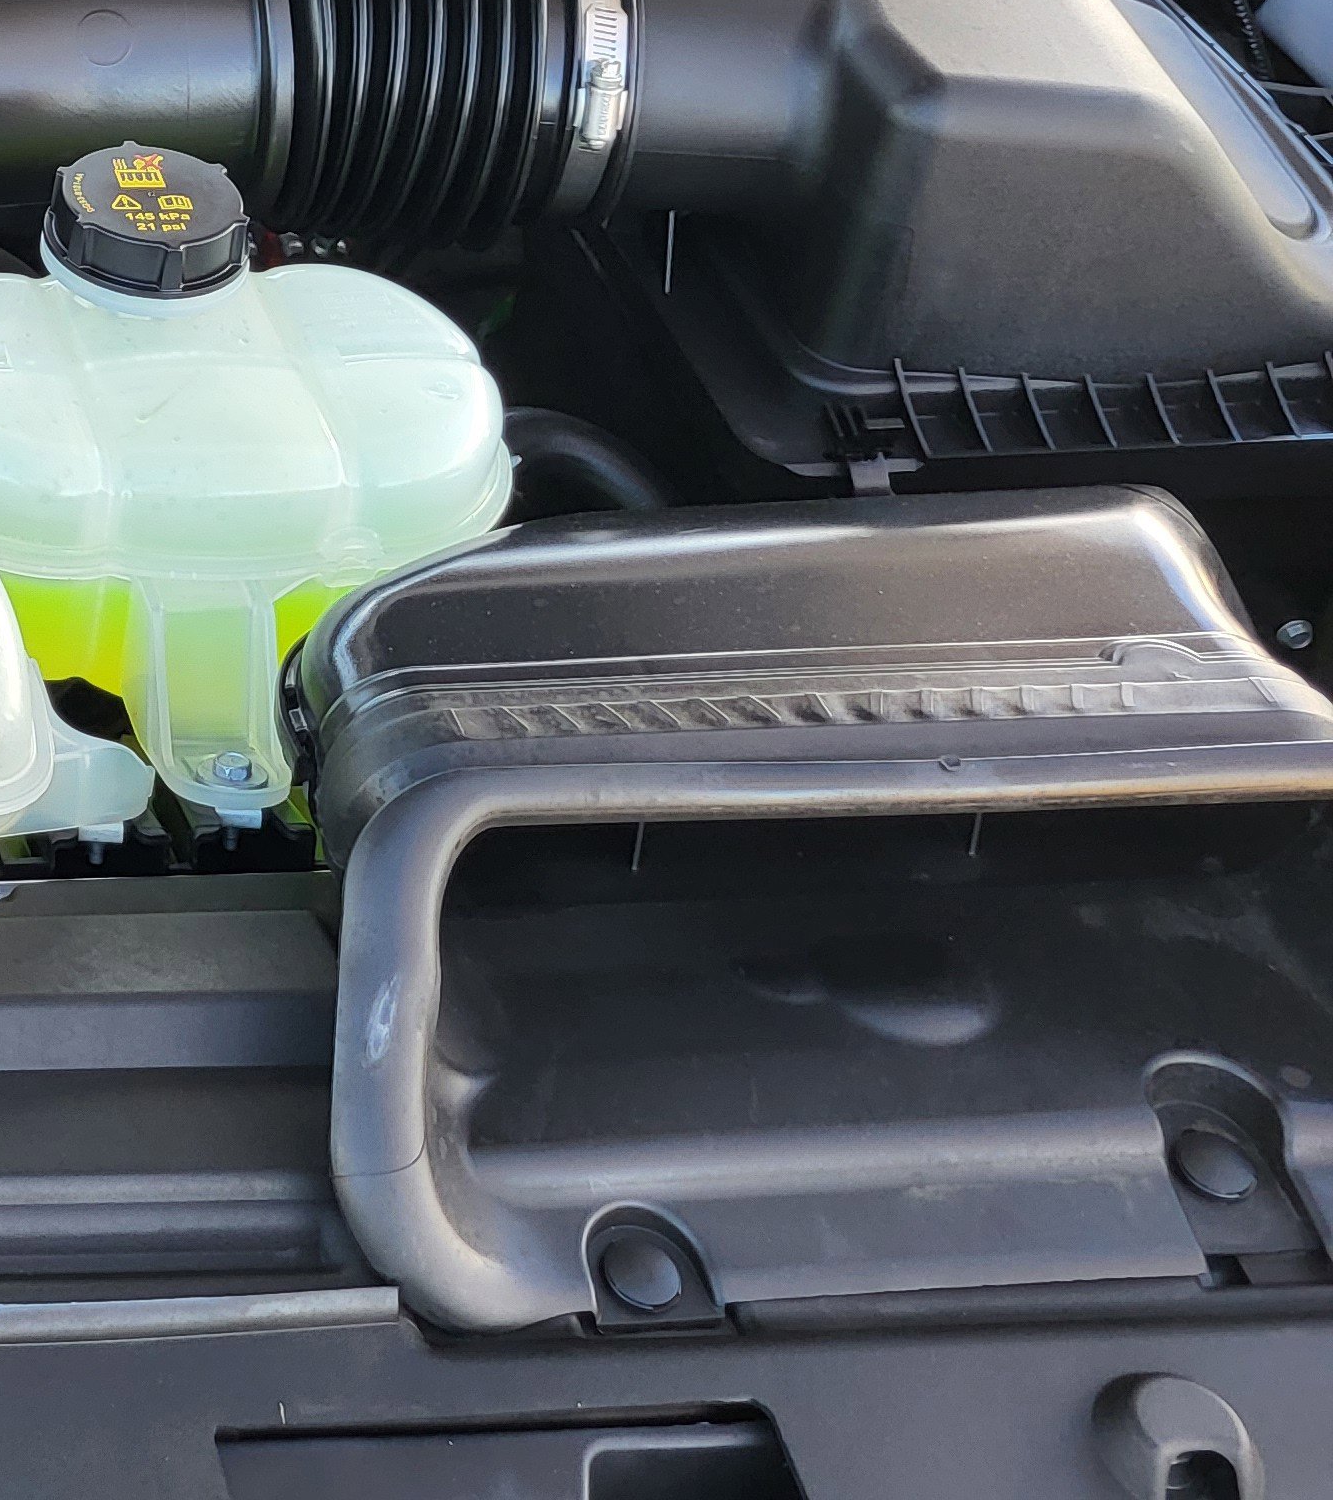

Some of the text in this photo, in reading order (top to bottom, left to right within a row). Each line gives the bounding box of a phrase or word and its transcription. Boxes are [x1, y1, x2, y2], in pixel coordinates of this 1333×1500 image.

[124, 212, 192, 221] 145 kPa
[136, 221, 187, 232] 21 psi
